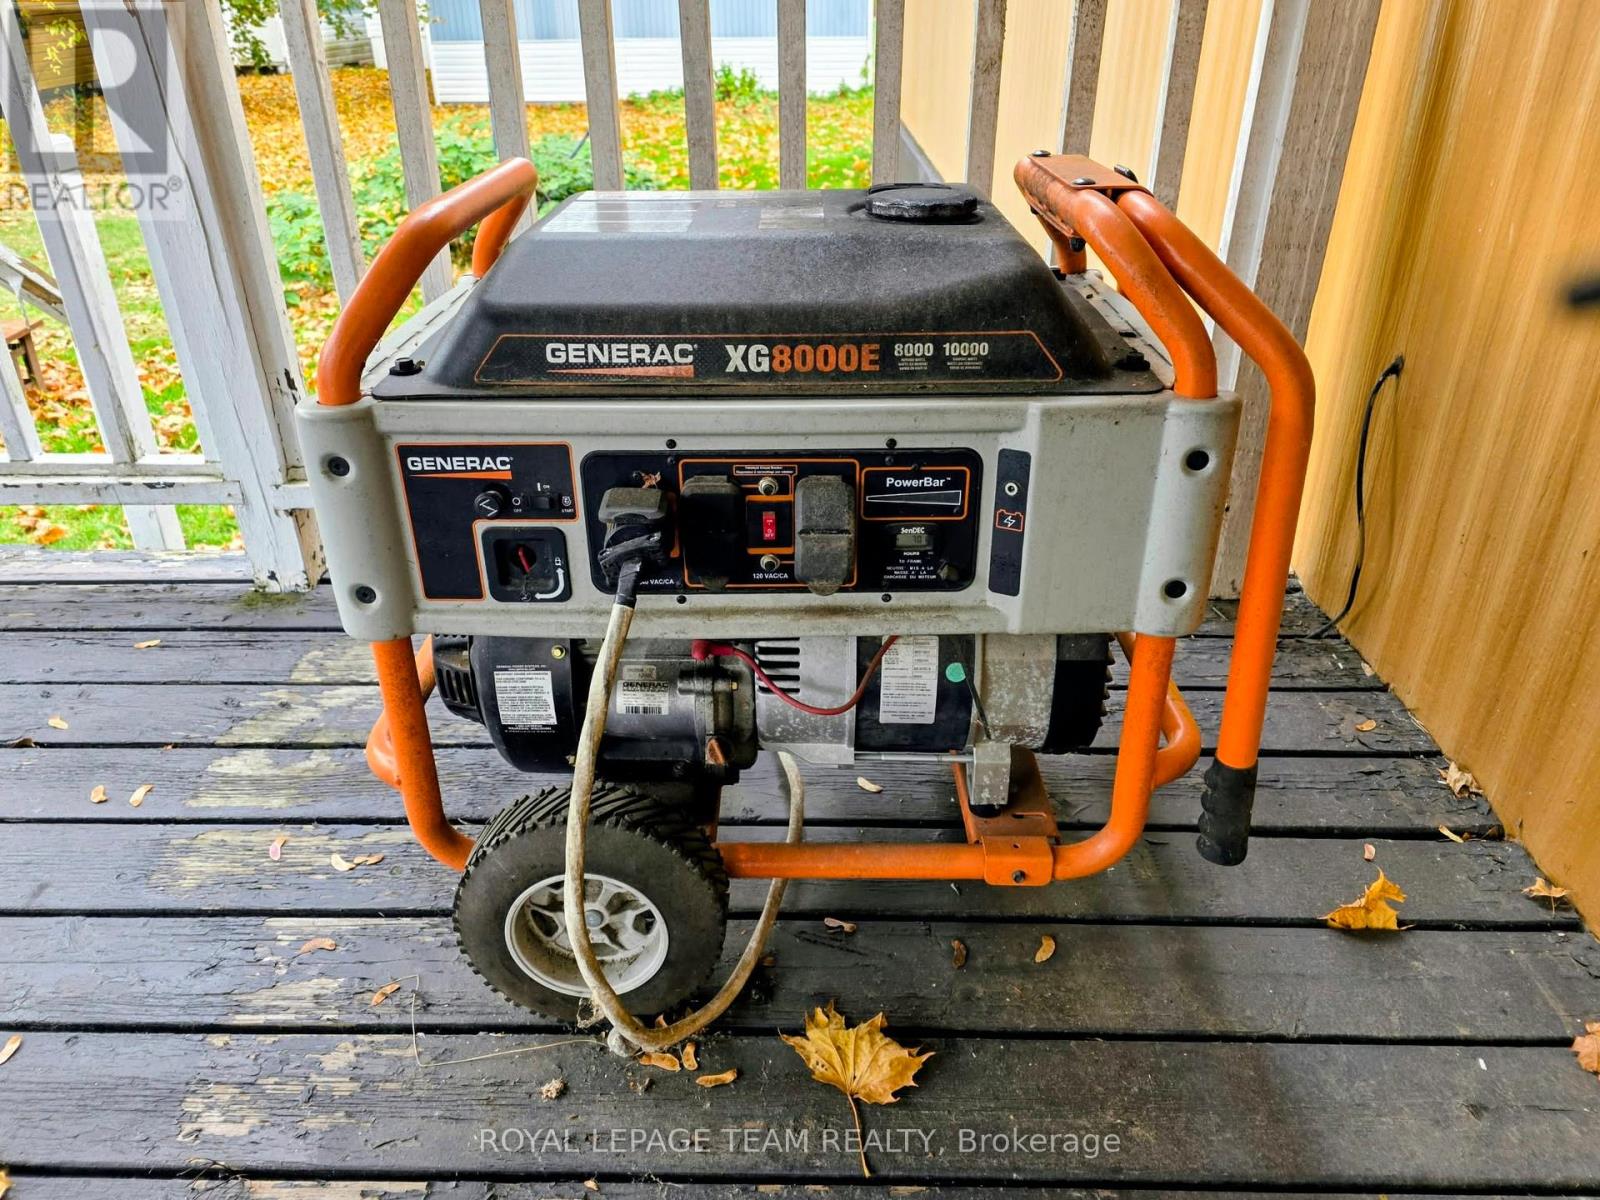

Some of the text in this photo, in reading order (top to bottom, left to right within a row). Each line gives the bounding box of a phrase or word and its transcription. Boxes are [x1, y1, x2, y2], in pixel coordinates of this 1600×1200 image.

[724, 344, 881, 373] XG8000E
[894, 343, 934, 357] 8000
[943, 342, 989, 356] 10000
[900, 526, 925, 534] SenDEC
